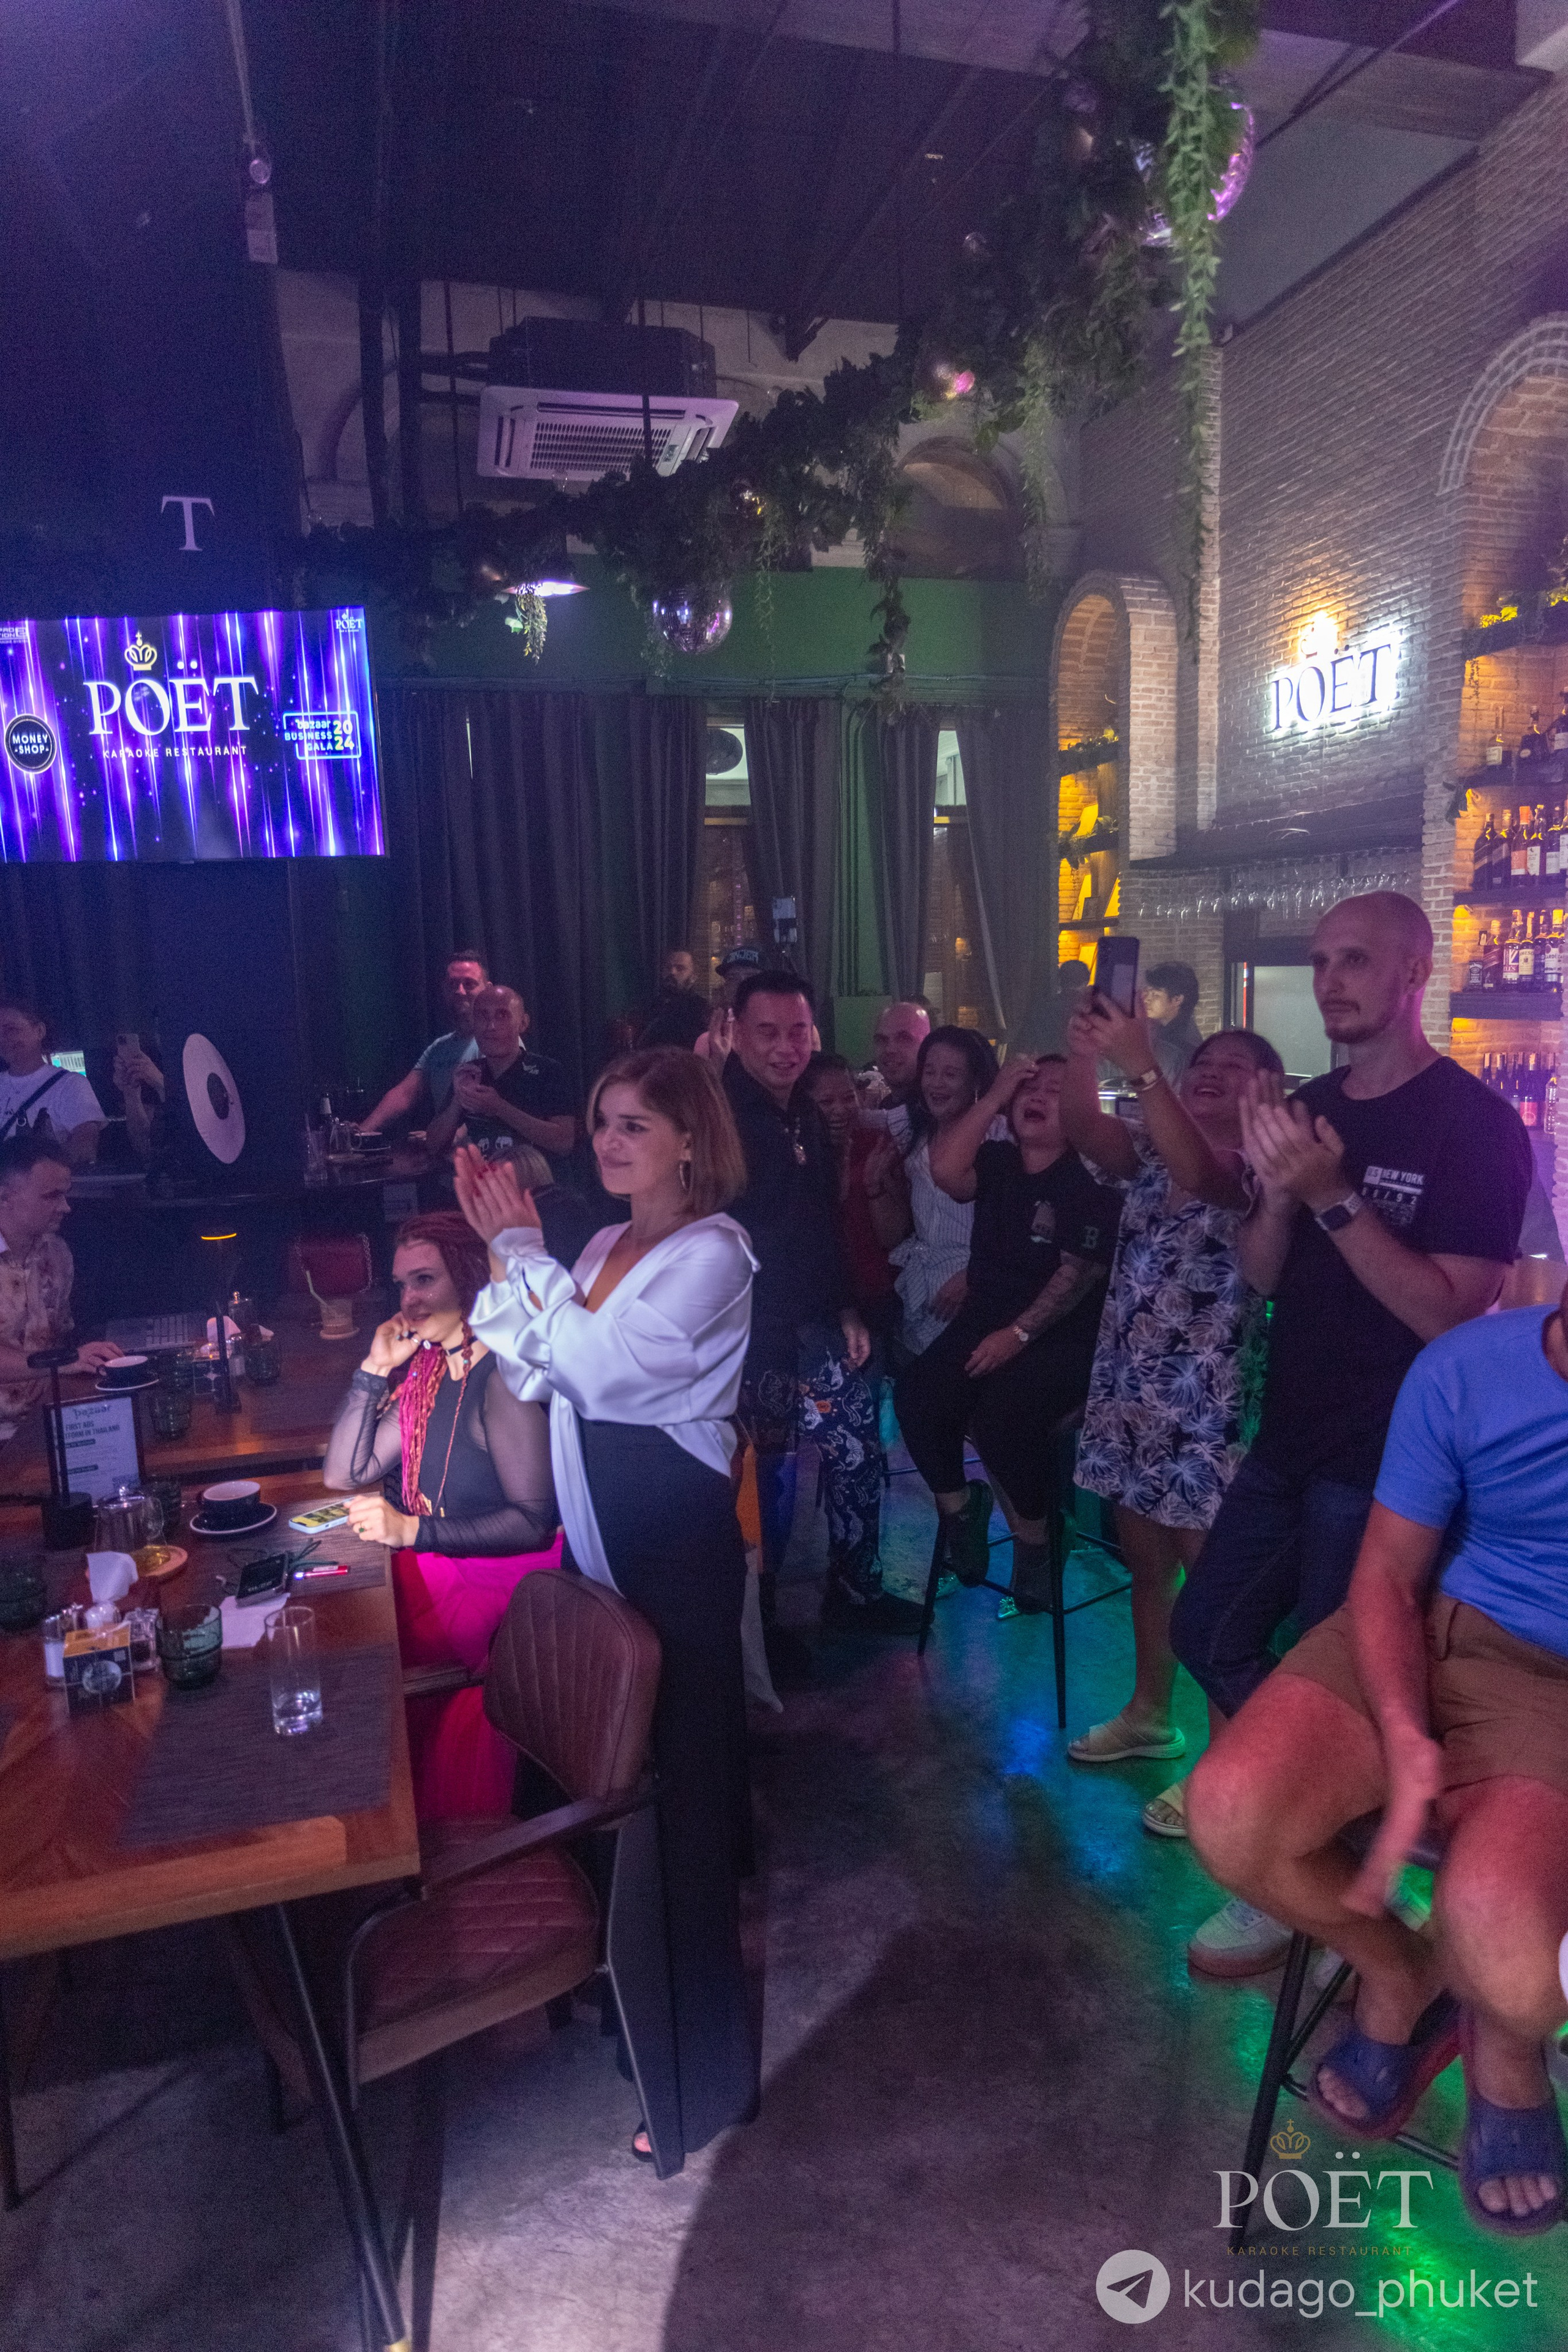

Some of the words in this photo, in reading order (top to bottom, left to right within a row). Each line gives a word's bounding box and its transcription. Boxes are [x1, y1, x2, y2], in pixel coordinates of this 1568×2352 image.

[161, 496, 215, 551] T
[1271, 644, 1392, 731] POËT
[82, 660, 259, 736] POËT
[333, 720, 353, 734] 20
[12, 734, 48, 744] MONEY
[284, 731, 333, 741] BUSINESS
[334, 736, 355, 750] 24
[103, 748, 159, 759] KARAOKE
[165, 745, 247, 757] RESTAURANT
[307, 742, 333, 751] GALA
[1400, 1171, 1423, 1185] YORK
